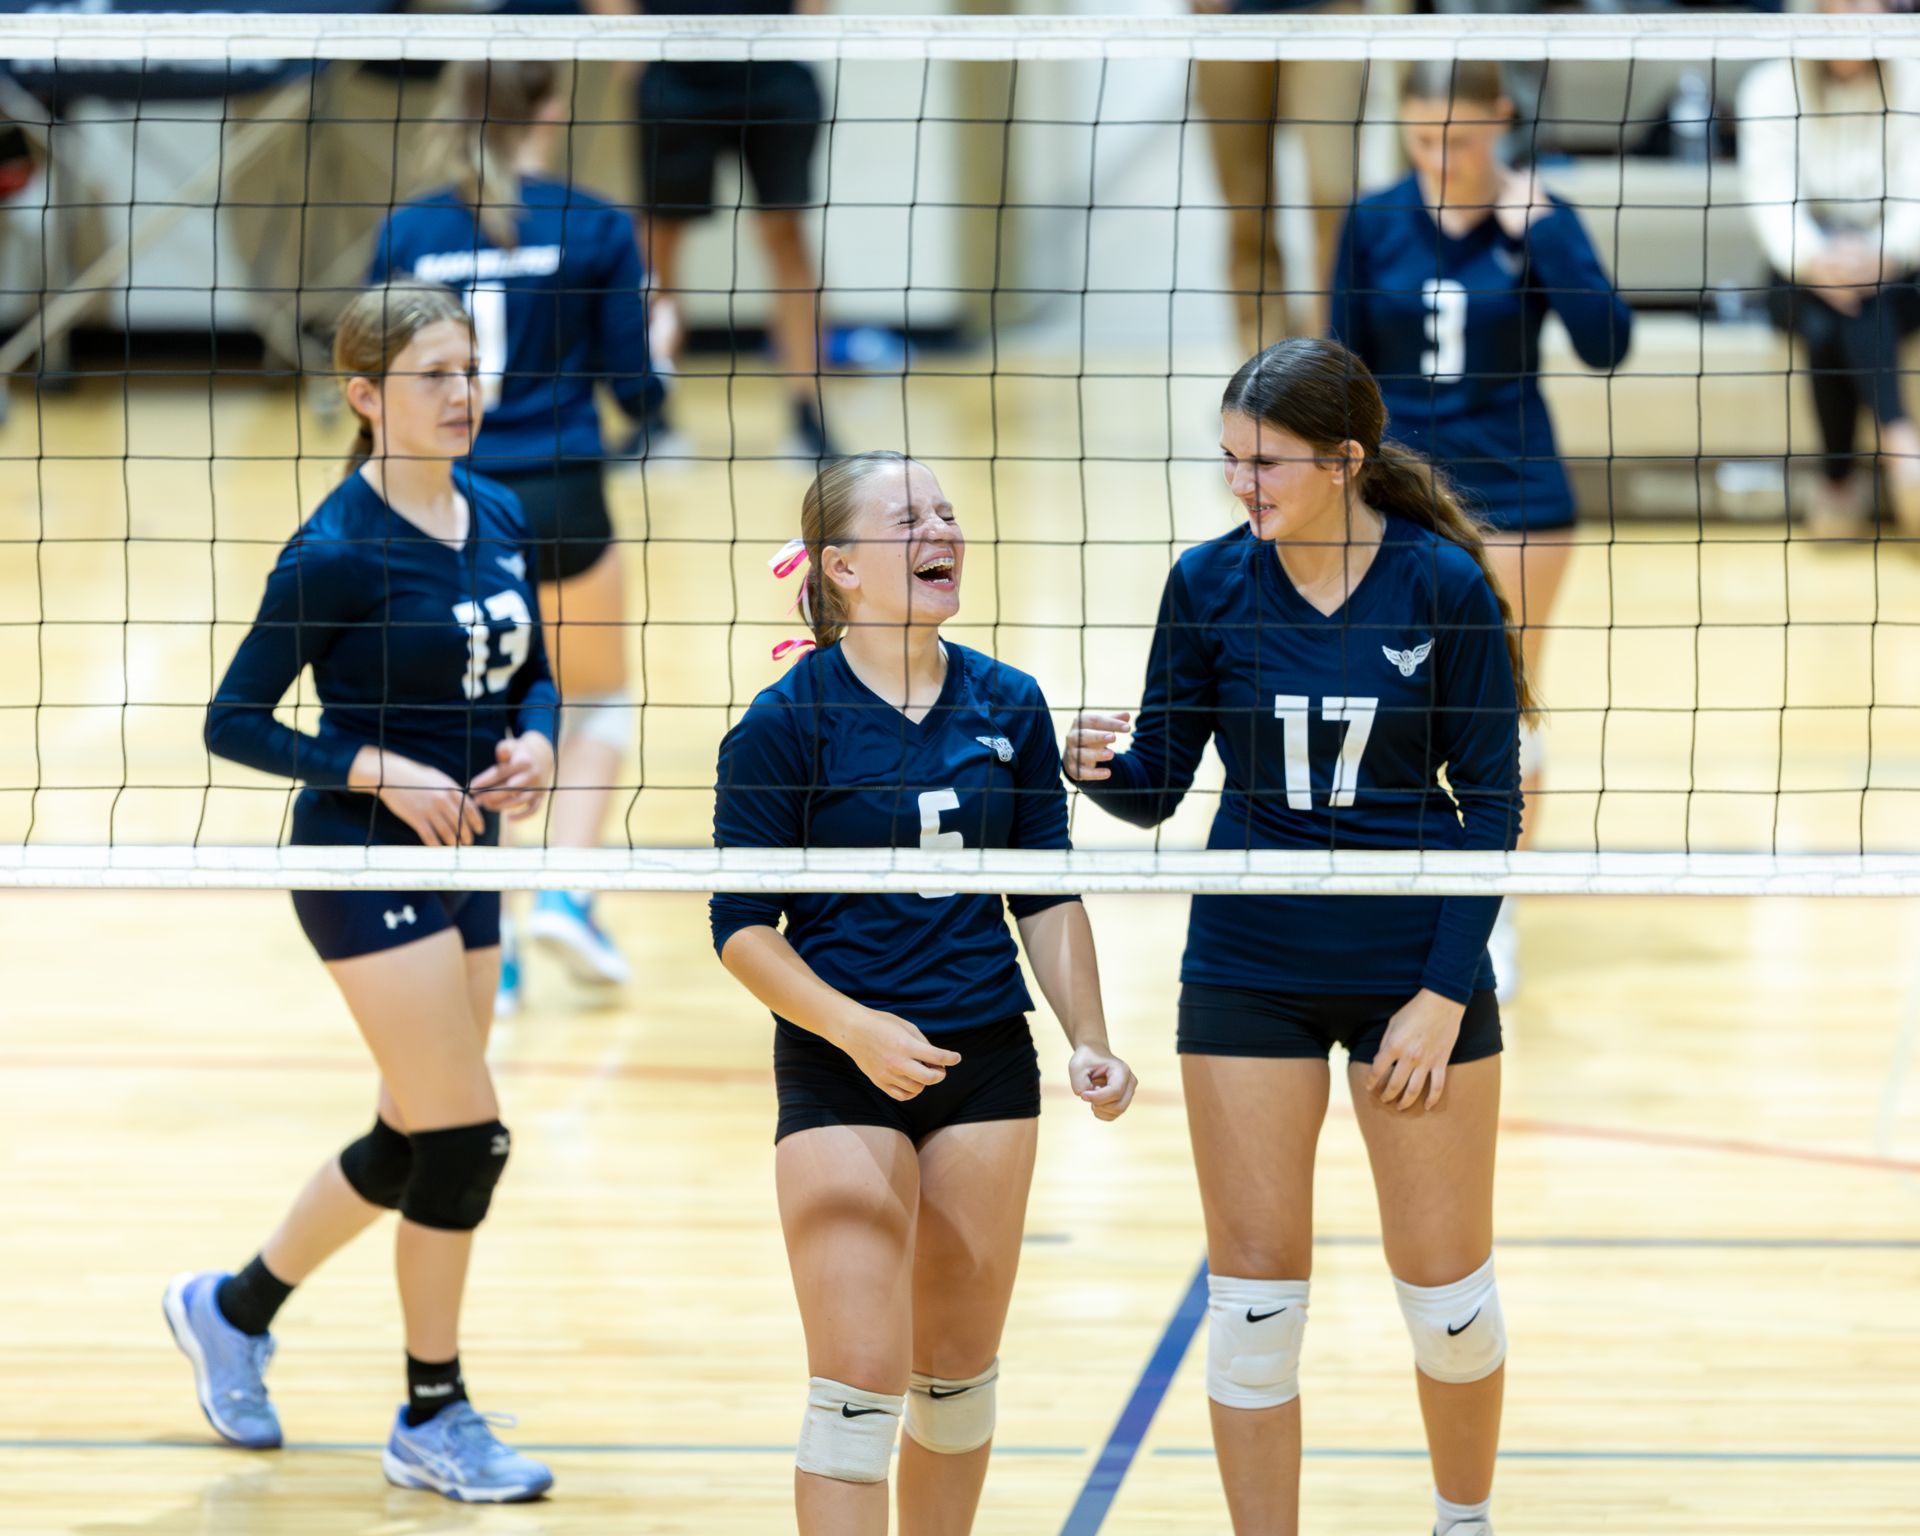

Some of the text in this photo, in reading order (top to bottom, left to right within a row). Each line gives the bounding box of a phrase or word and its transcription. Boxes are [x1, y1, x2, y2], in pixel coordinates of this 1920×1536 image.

[1420, 278, 1467, 384] 3
[452, 589, 532, 699] 13
[1274, 694, 1379, 810] 17
